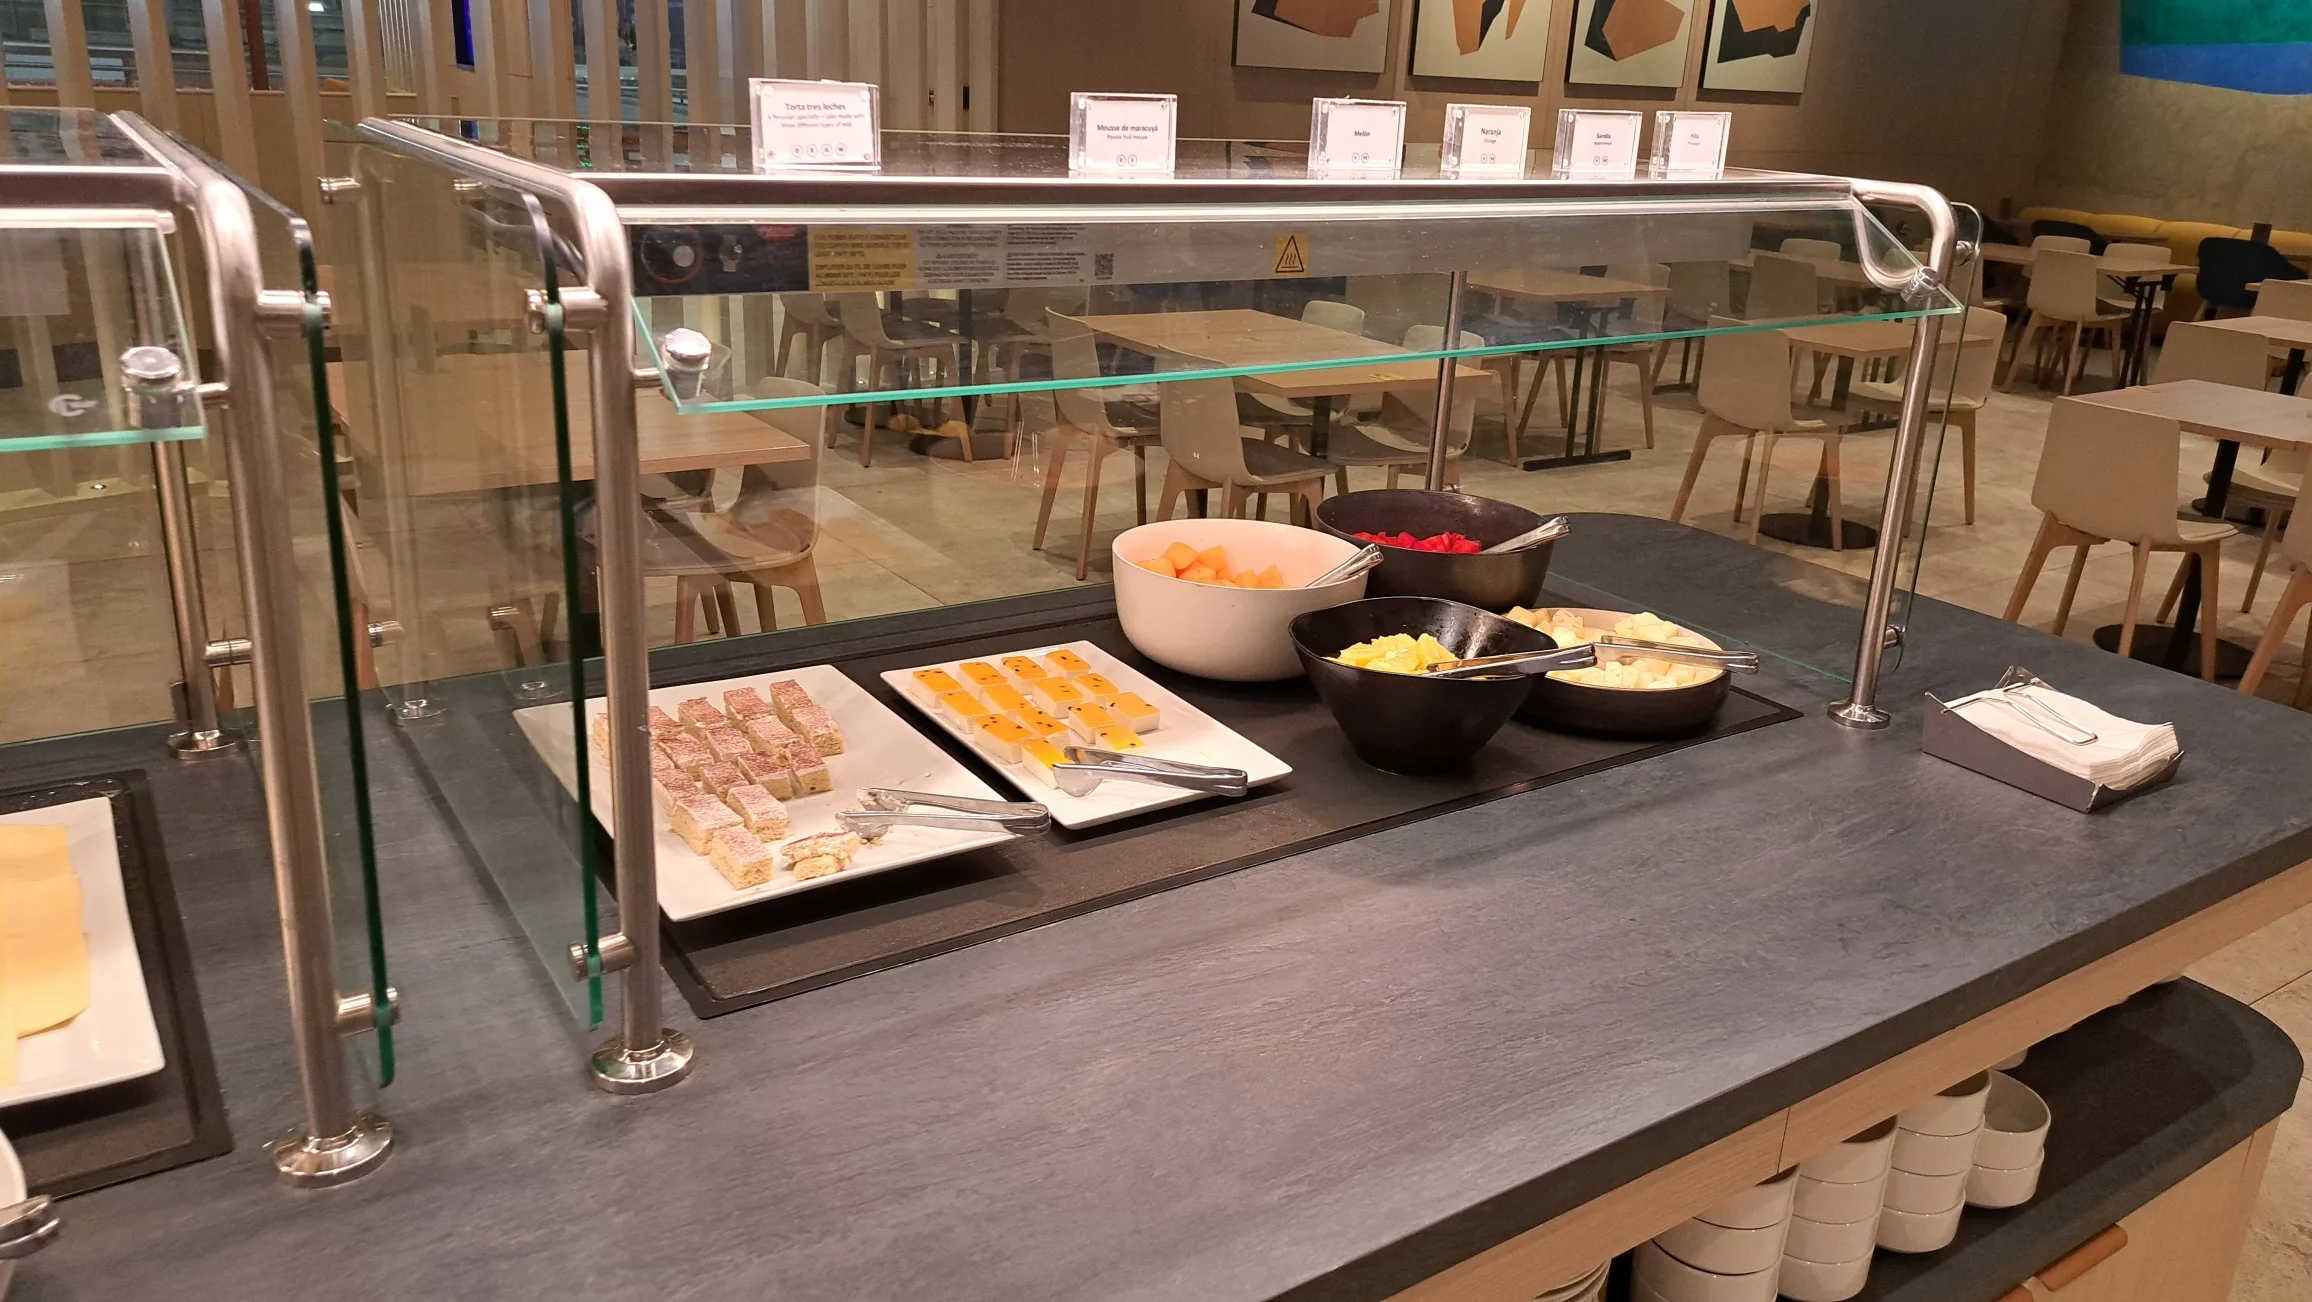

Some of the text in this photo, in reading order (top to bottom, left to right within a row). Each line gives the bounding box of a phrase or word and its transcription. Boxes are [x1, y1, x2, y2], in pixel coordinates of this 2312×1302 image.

[823, 102, 846, 110] leches
[1130, 124, 1158, 133] maracuyá
[1481, 128, 1502, 137] Naranja
